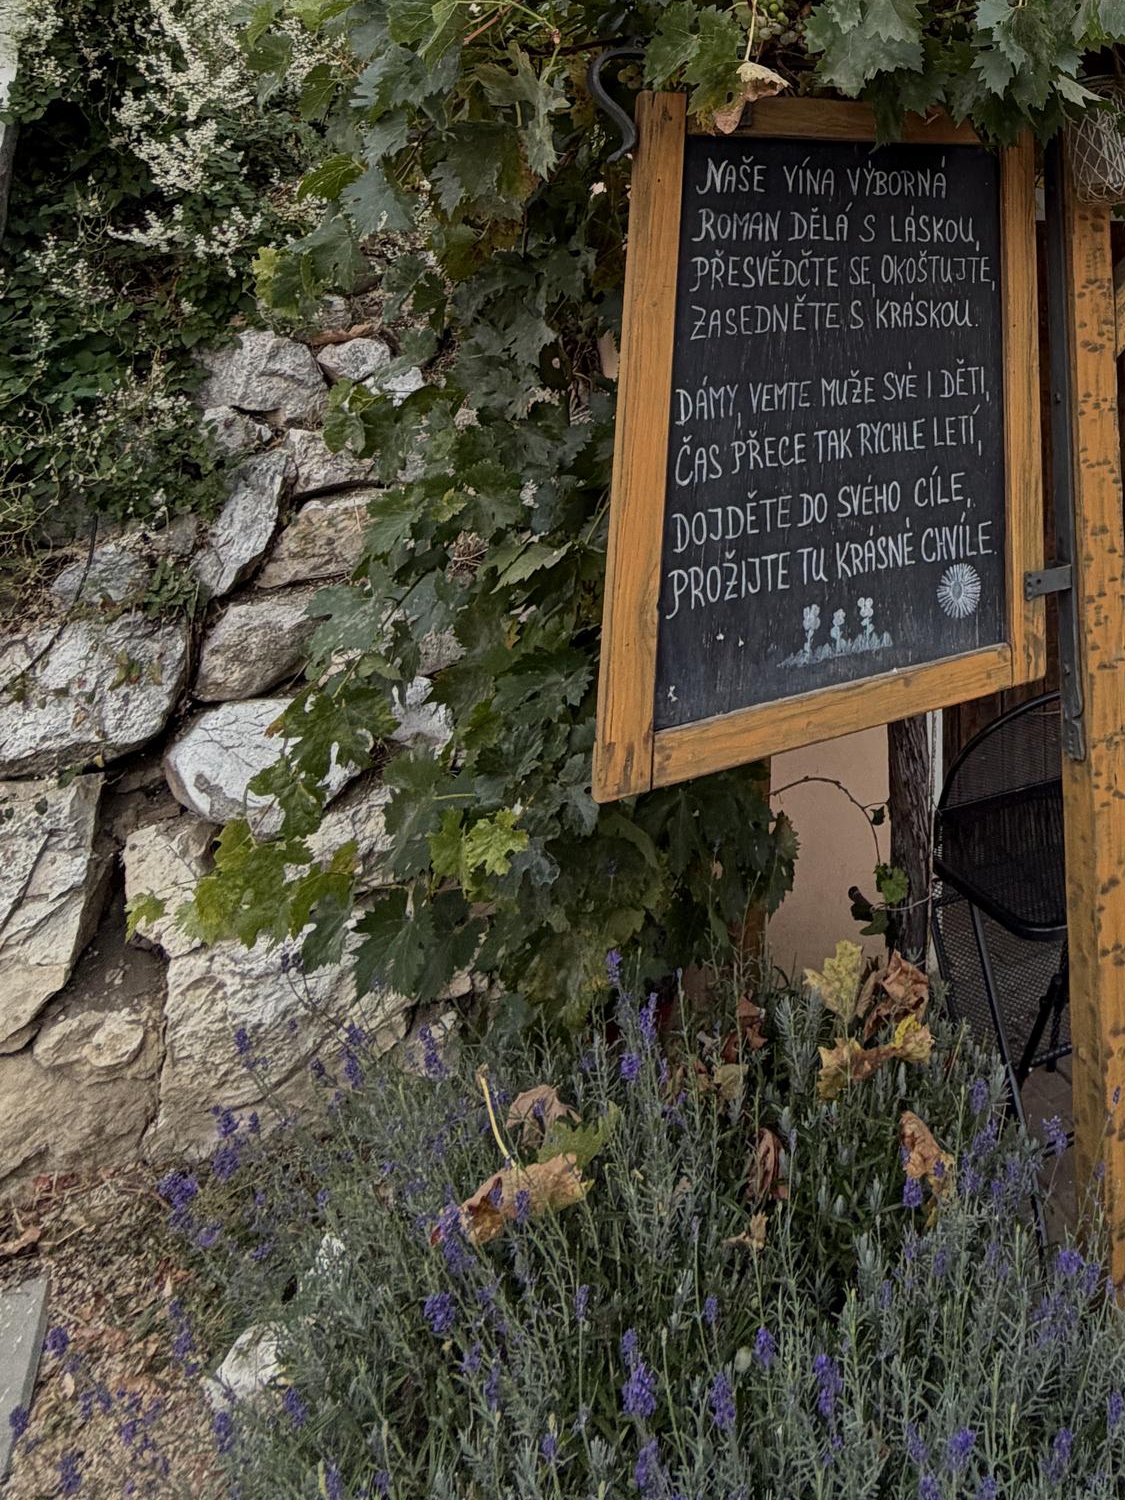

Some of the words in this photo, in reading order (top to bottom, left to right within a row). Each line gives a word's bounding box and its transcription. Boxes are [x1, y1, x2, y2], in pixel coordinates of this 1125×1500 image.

[695, 156, 767, 195] NAŠE
[783, 156, 835, 196] VÍNA
[847, 156, 947, 198] VÝBORNÁ
[691, 207, 780, 242] ROMAN
[788, 202, 853, 242] DĚLÁ
[859, 215, 876, 242] S
[890, 205, 980, 251] LÁSKOU,
[689, 249, 838, 292] PŘESVĚDČTE
[849, 257, 876, 297] SE,
[881, 248, 996, 291] OKOŠTUJTE,
[689, 294, 840, 340] ZASEDNĚTE
[849, 301, 864, 329] S
[876, 291, 978, 329] KRÁSKOU.
[675, 375, 742, 429] DÁMY,
[749, 380, 812, 414] VEMTE
[821, 370, 876, 405] MUŽE
[882, 362, 917, 400] SVÉ
[927, 371, 931, 398] I
[940, 358, 990, 402] DĚTI,
[675, 436, 722, 486] ČAS
[731, 429, 806, 474] PŘECE
[814, 429, 851, 462] TAK
[857, 418, 925, 456] RYCHLE
[933, 405, 982, 455] LETÍ,
[672, 490, 792, 553] DOJDĚTE
[797, 492, 828, 528] DO
[837, 471, 900, 517] SVÉHO
[914, 465, 971, 507] CÍLE,
[666, 549, 791, 619] PROŽIJTE
[797, 547, 828, 586] TU
[836, 517, 915, 578] KRÁSNÉ
[921, 511, 997, 564] CHVÍLE.
